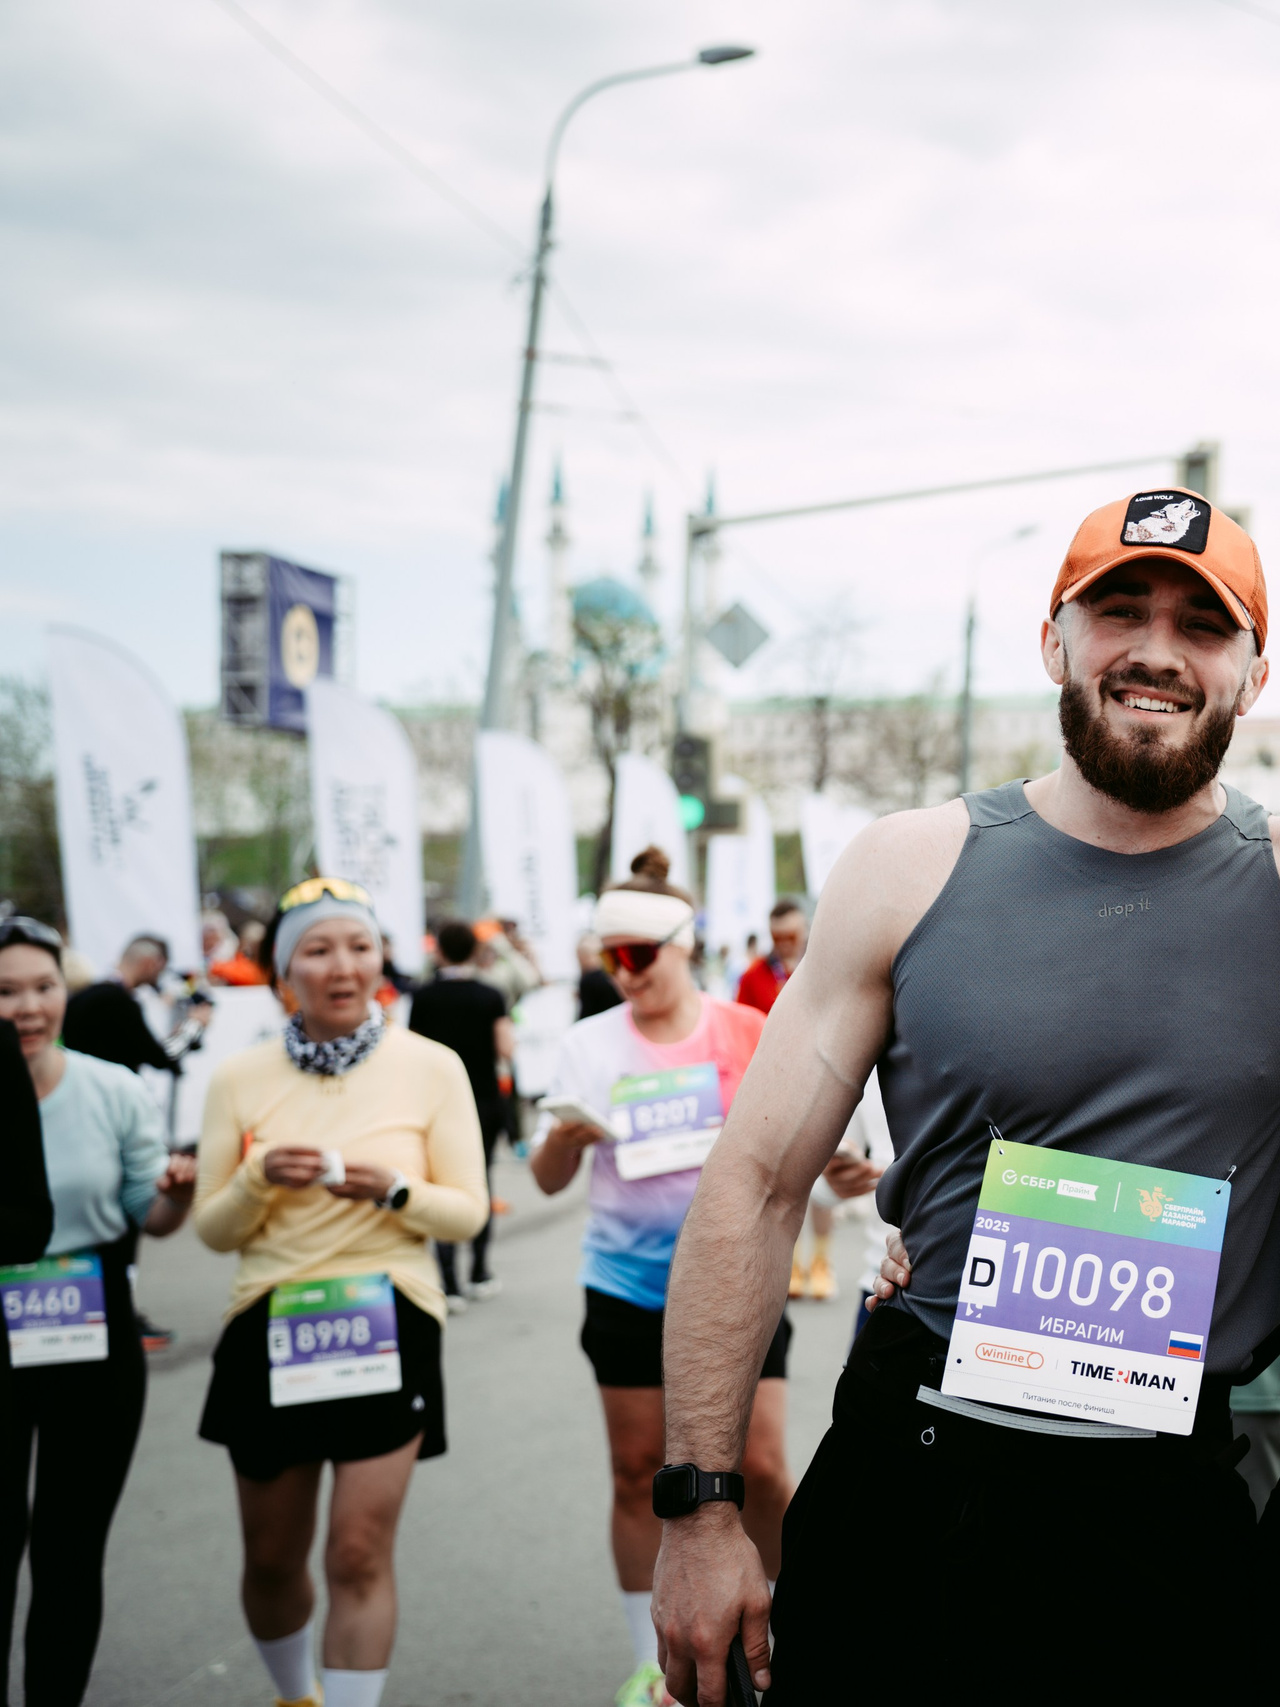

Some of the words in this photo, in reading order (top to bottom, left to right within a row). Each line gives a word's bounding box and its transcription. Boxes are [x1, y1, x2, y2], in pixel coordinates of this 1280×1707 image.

[1098, 903, 1134, 917] drop
[1138, 898, 1151, 911] it
[1020, 1175, 1056, 1190] СБЕР
[1062, 1183, 1090, 1195] Прайм
[1162, 1210, 1206, 1224] КАЗАНСКИЙ
[1164, 1203, 1204, 1216] СБЕРПРАЙМ
[975, 1216, 1011, 1233] 2025
[1161, 1217, 1197, 1229] МАРАФОН
[968, 1257, 996, 1287] D
[1011, 1241, 1175, 1319] 10098
[3, 1285, 82, 1320] 5460
[295, 1315, 371, 1353] 8998
[1039, 1315, 1125, 1345] ИБРАГИМ
[982, 1347, 1025, 1363] Winline
[1022, 1391, 1056, 1404] Питание
[1058, 1399, 1082, 1409] после
[1083, 1403, 1115, 1415] финиша
